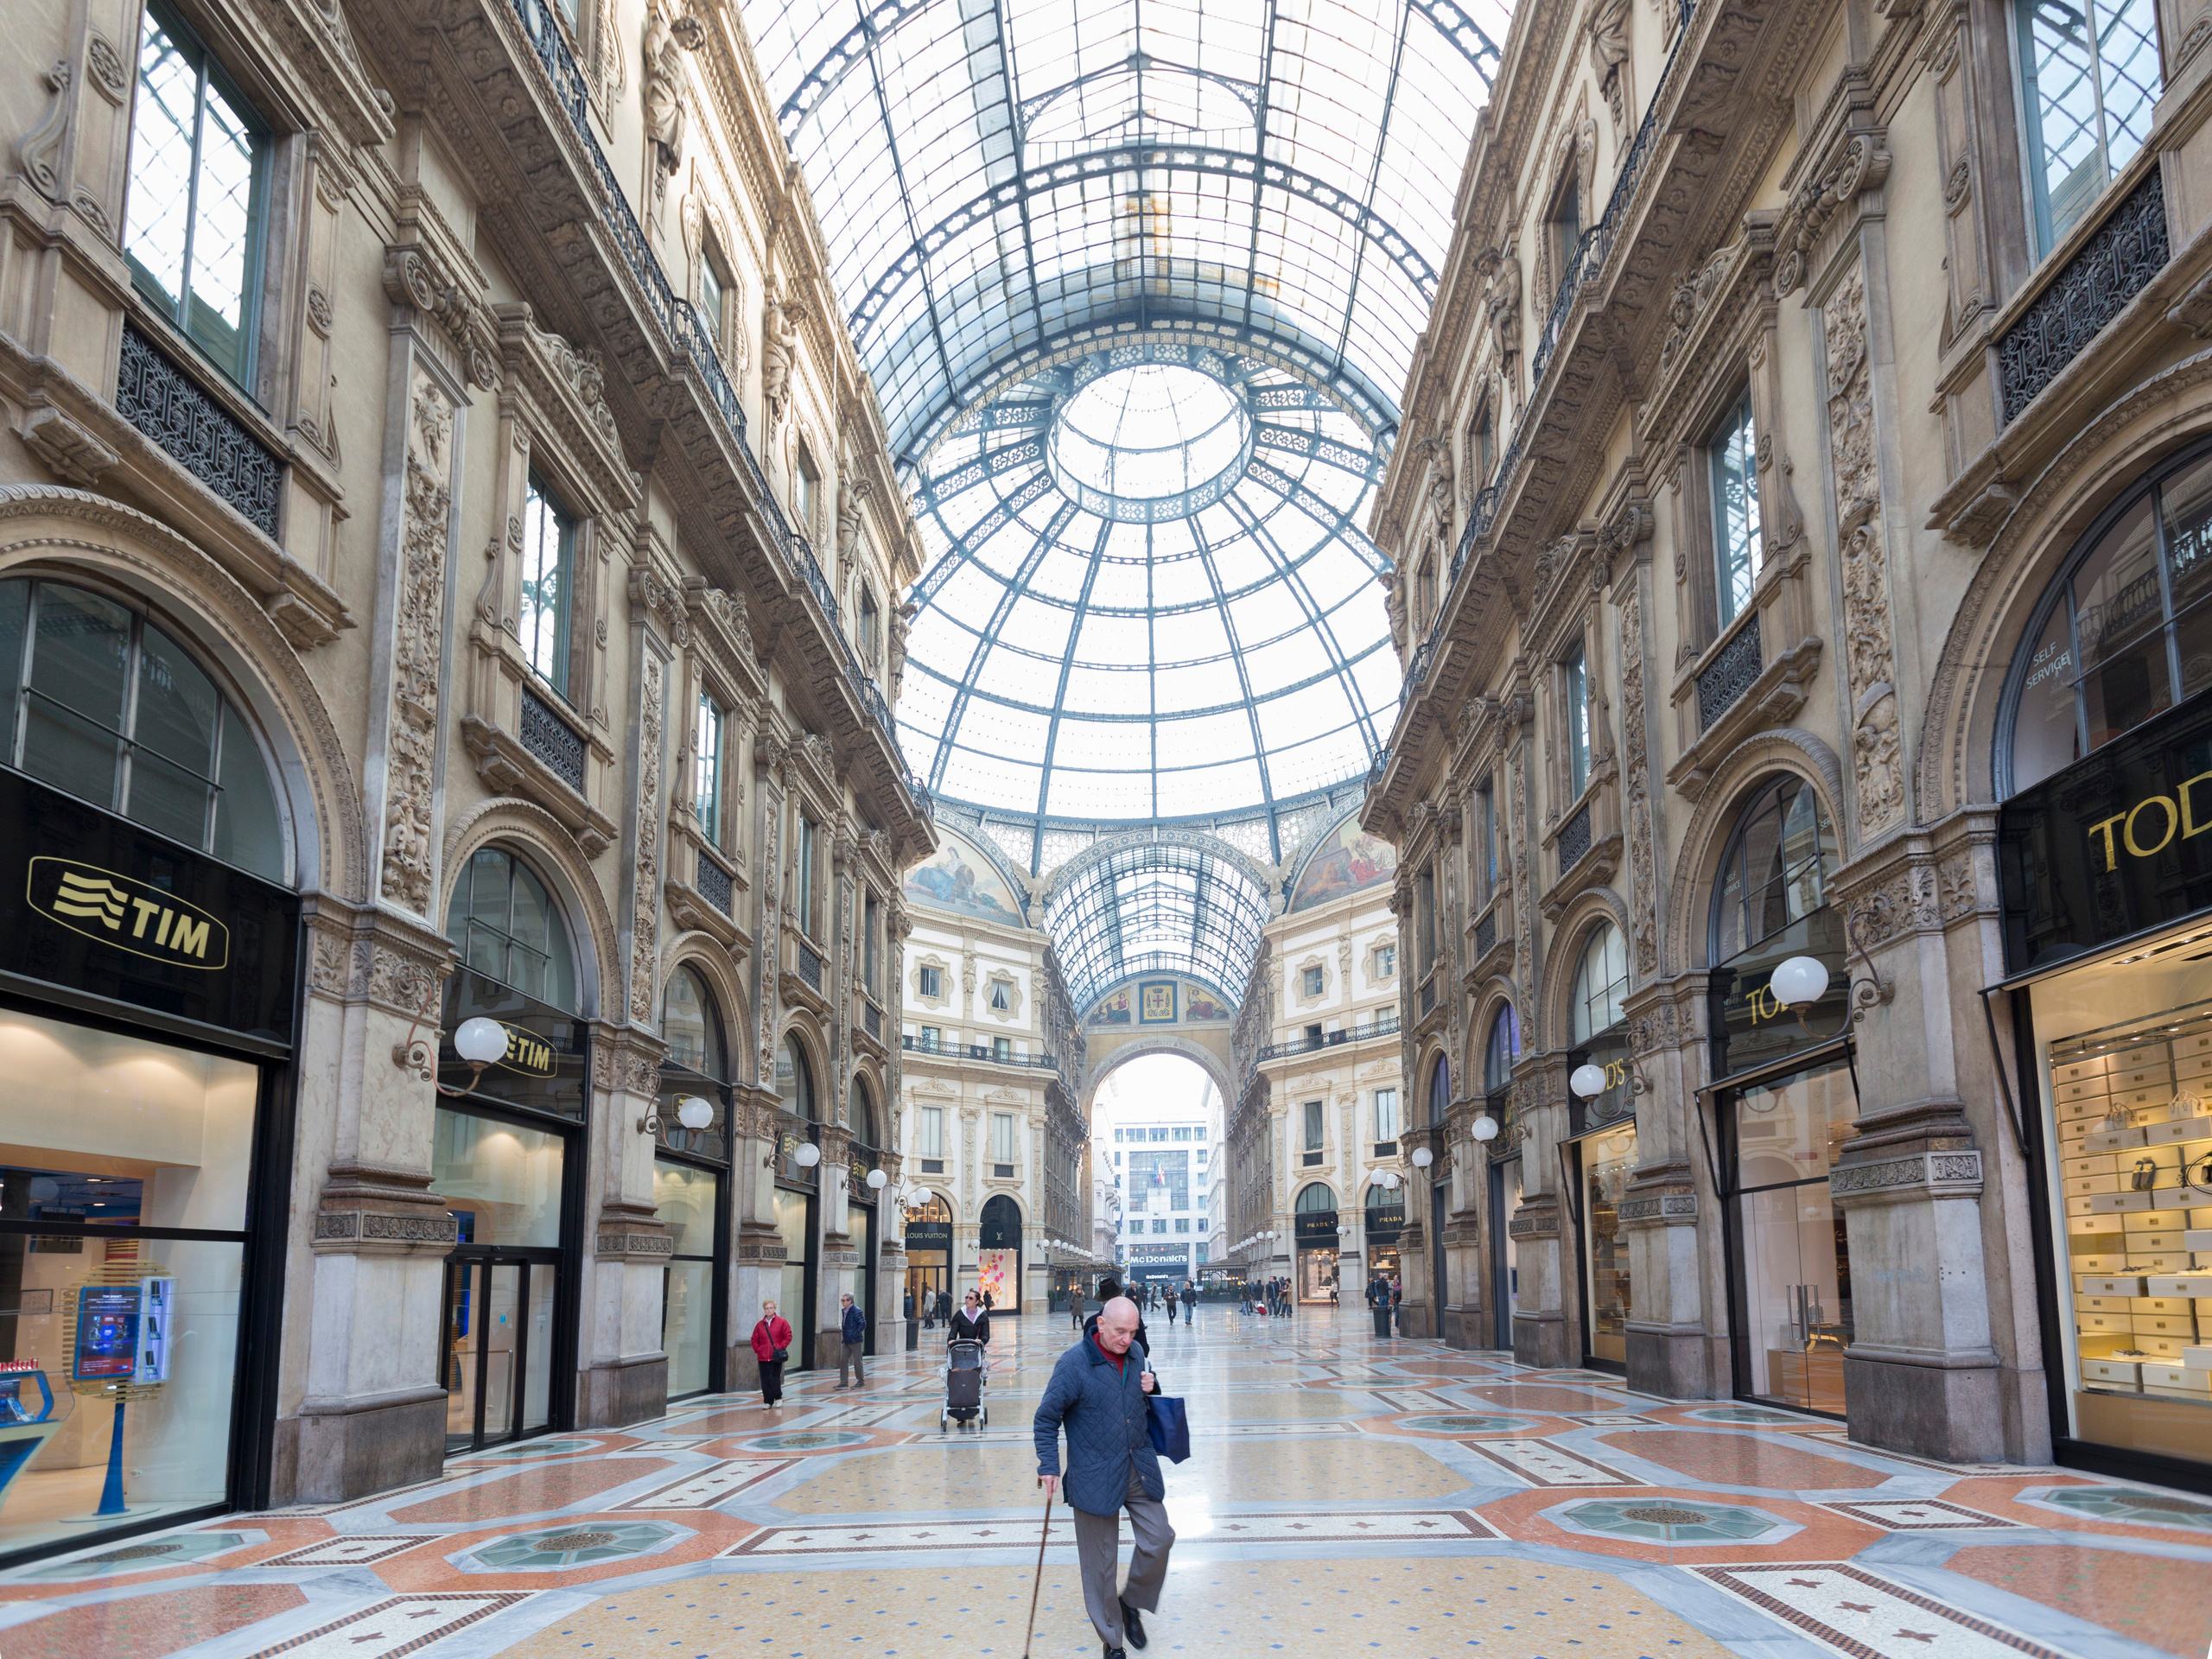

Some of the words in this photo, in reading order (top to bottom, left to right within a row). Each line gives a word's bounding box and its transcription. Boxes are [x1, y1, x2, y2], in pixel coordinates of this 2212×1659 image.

[2033, 641, 2056, 668] SELF
[132, 896, 210, 959] TIM
[518, 1037, 550, 1071] TIM
[1130, 1255, 1188, 1264] McDonald's
